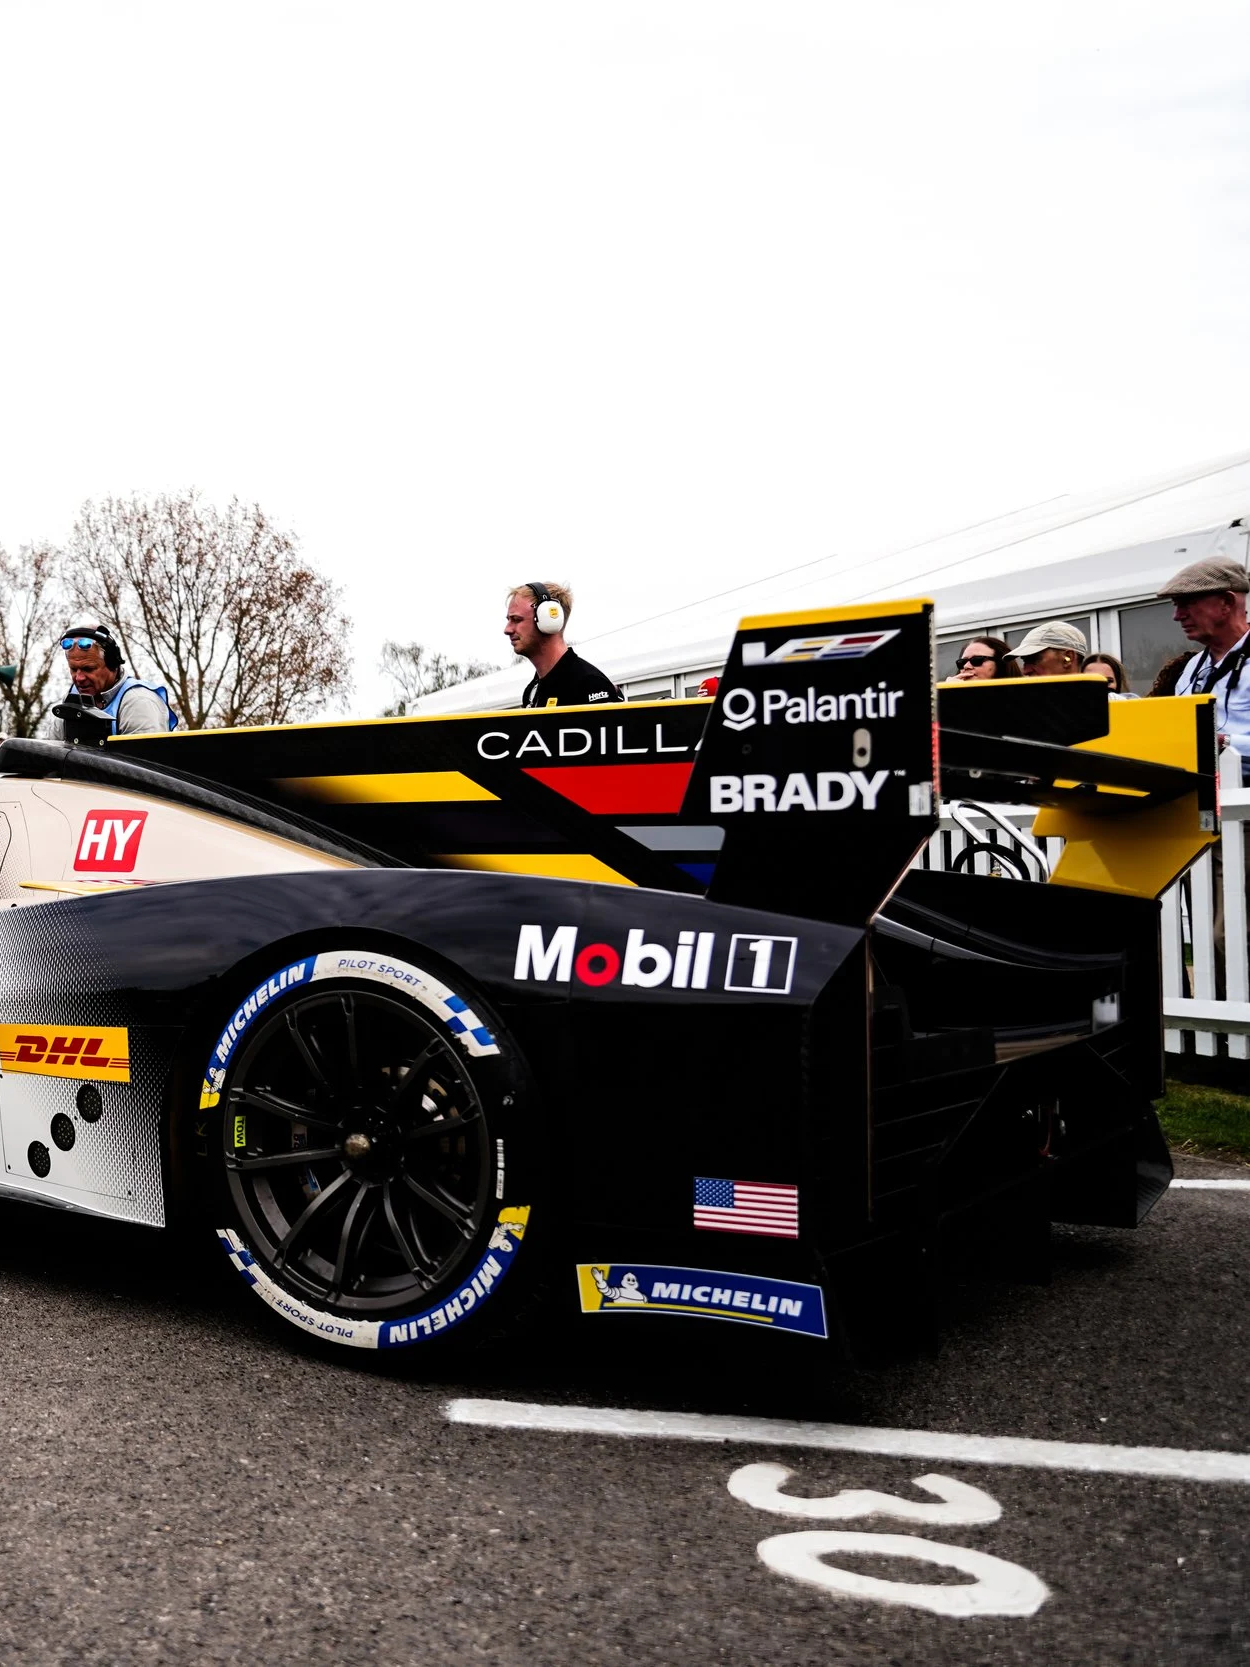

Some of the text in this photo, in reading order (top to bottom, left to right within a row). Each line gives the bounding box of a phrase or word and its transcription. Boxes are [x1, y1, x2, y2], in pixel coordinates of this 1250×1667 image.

[588, 691, 609, 702] Hertz
[763, 681, 904, 725] Palantir
[477, 723, 703, 760] CADILL
[709, 770, 889, 813] BRADY
[78, 819, 142, 861] HY
[338, 958, 423, 987] PILOT SPORT
[513, 924, 715, 989] Mobil
[215, 962, 307, 1064] MICHELIN
[14, 1034, 111, 1068] DHL
[236, 1116, 245, 1145] TOW
[275, 1299, 354, 1339] PILOT SPORT
[389, 1254, 503, 1344] MICHELIN
[651, 1282, 803, 1317] MICHELIN
[727, 1462, 1050, 1617] 30
